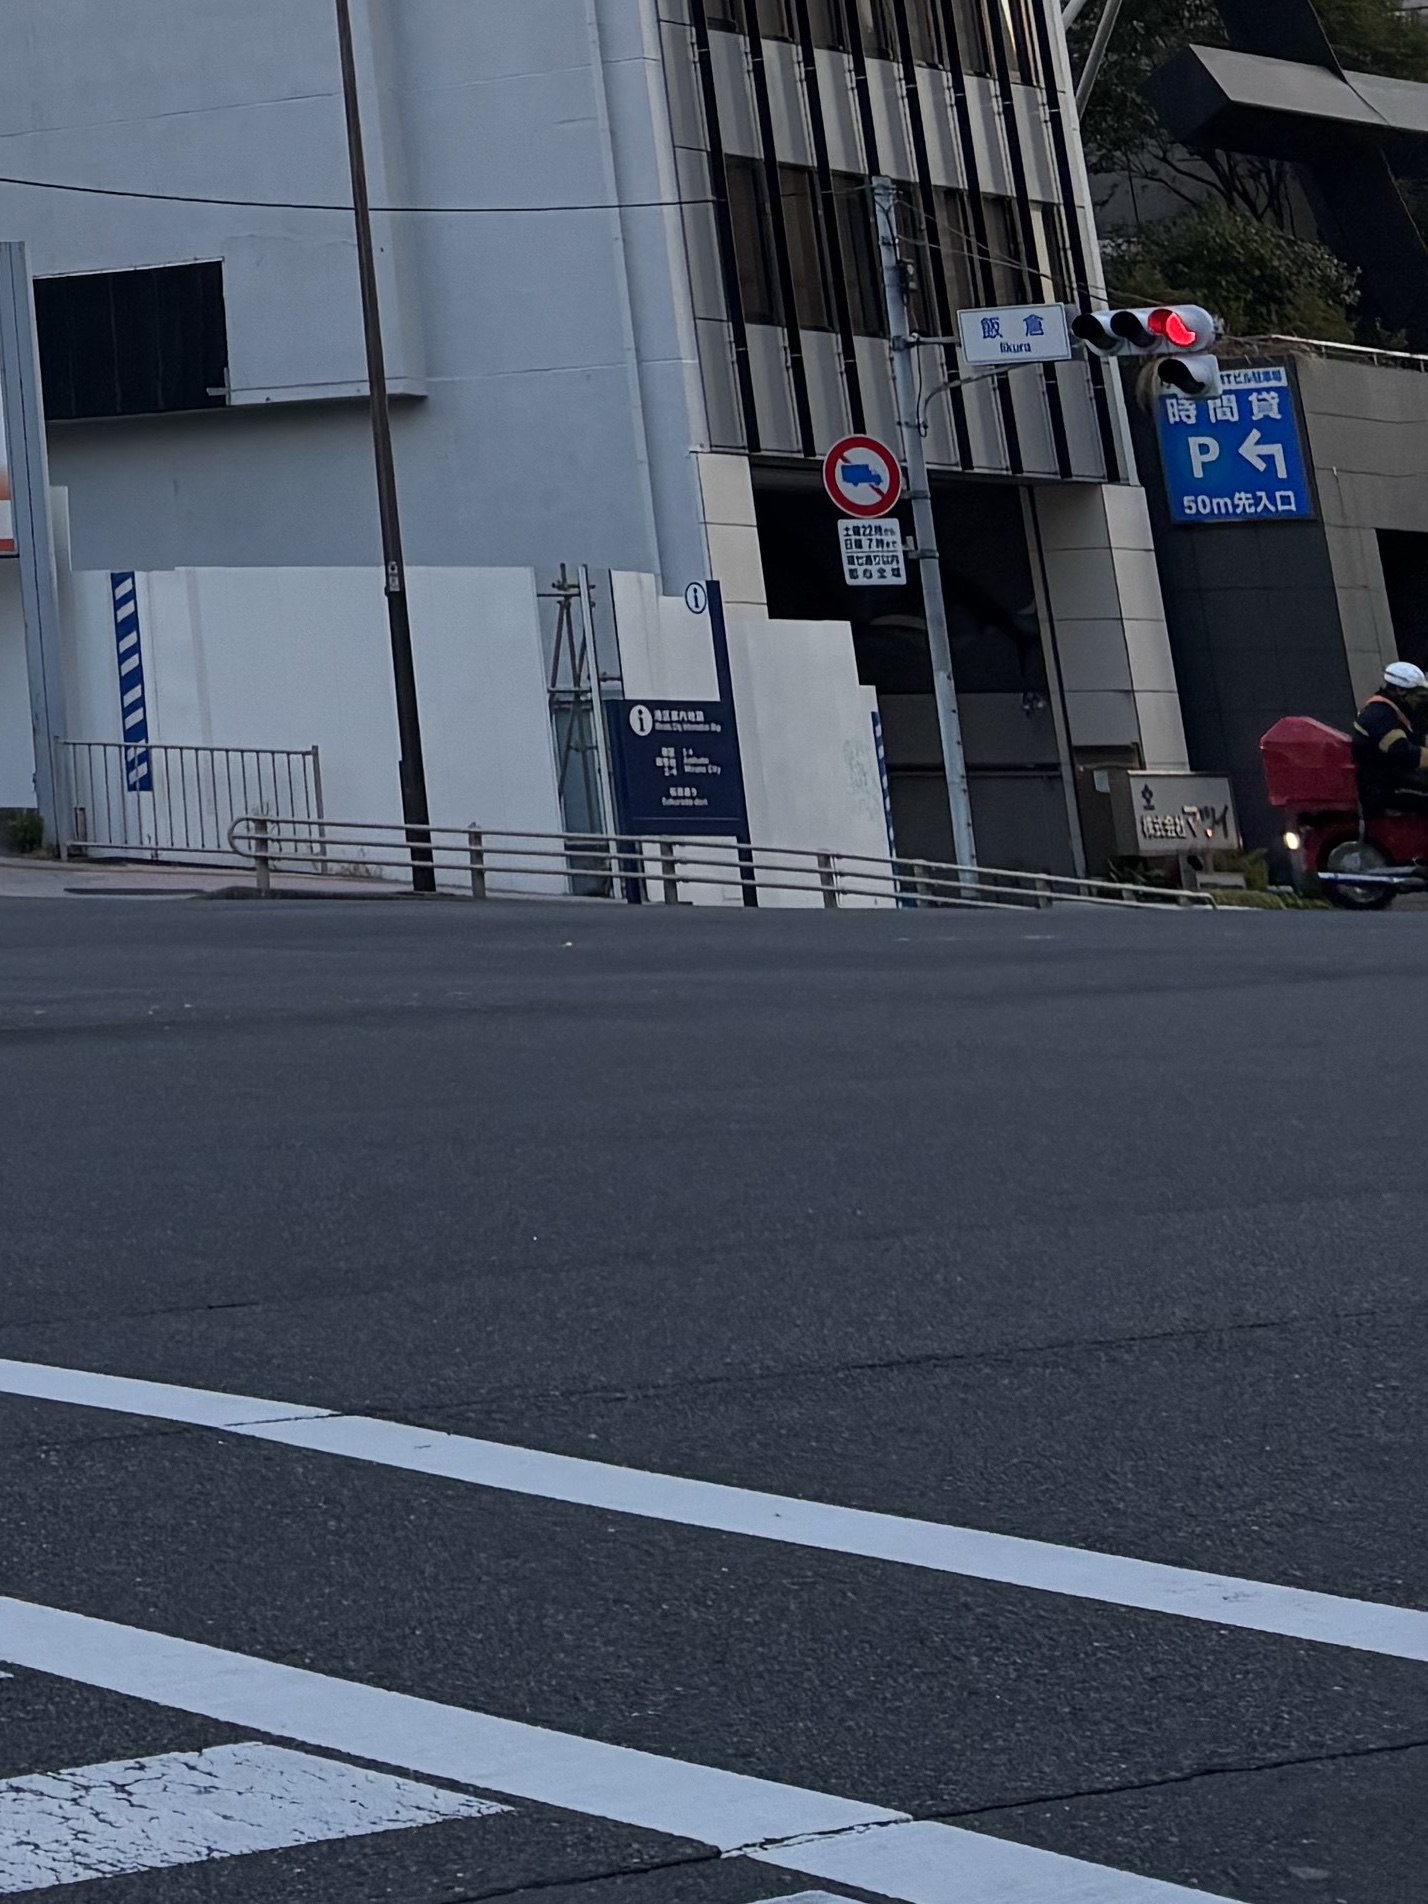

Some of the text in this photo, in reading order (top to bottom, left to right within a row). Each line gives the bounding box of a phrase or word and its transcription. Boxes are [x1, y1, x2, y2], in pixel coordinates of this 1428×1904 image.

[980, 313, 1045, 339] 飯倉
[1165, 390, 1282, 425] 時間貸
[1187, 436, 1220, 479] P
[1182, 490, 1297, 515] 50m先入口
